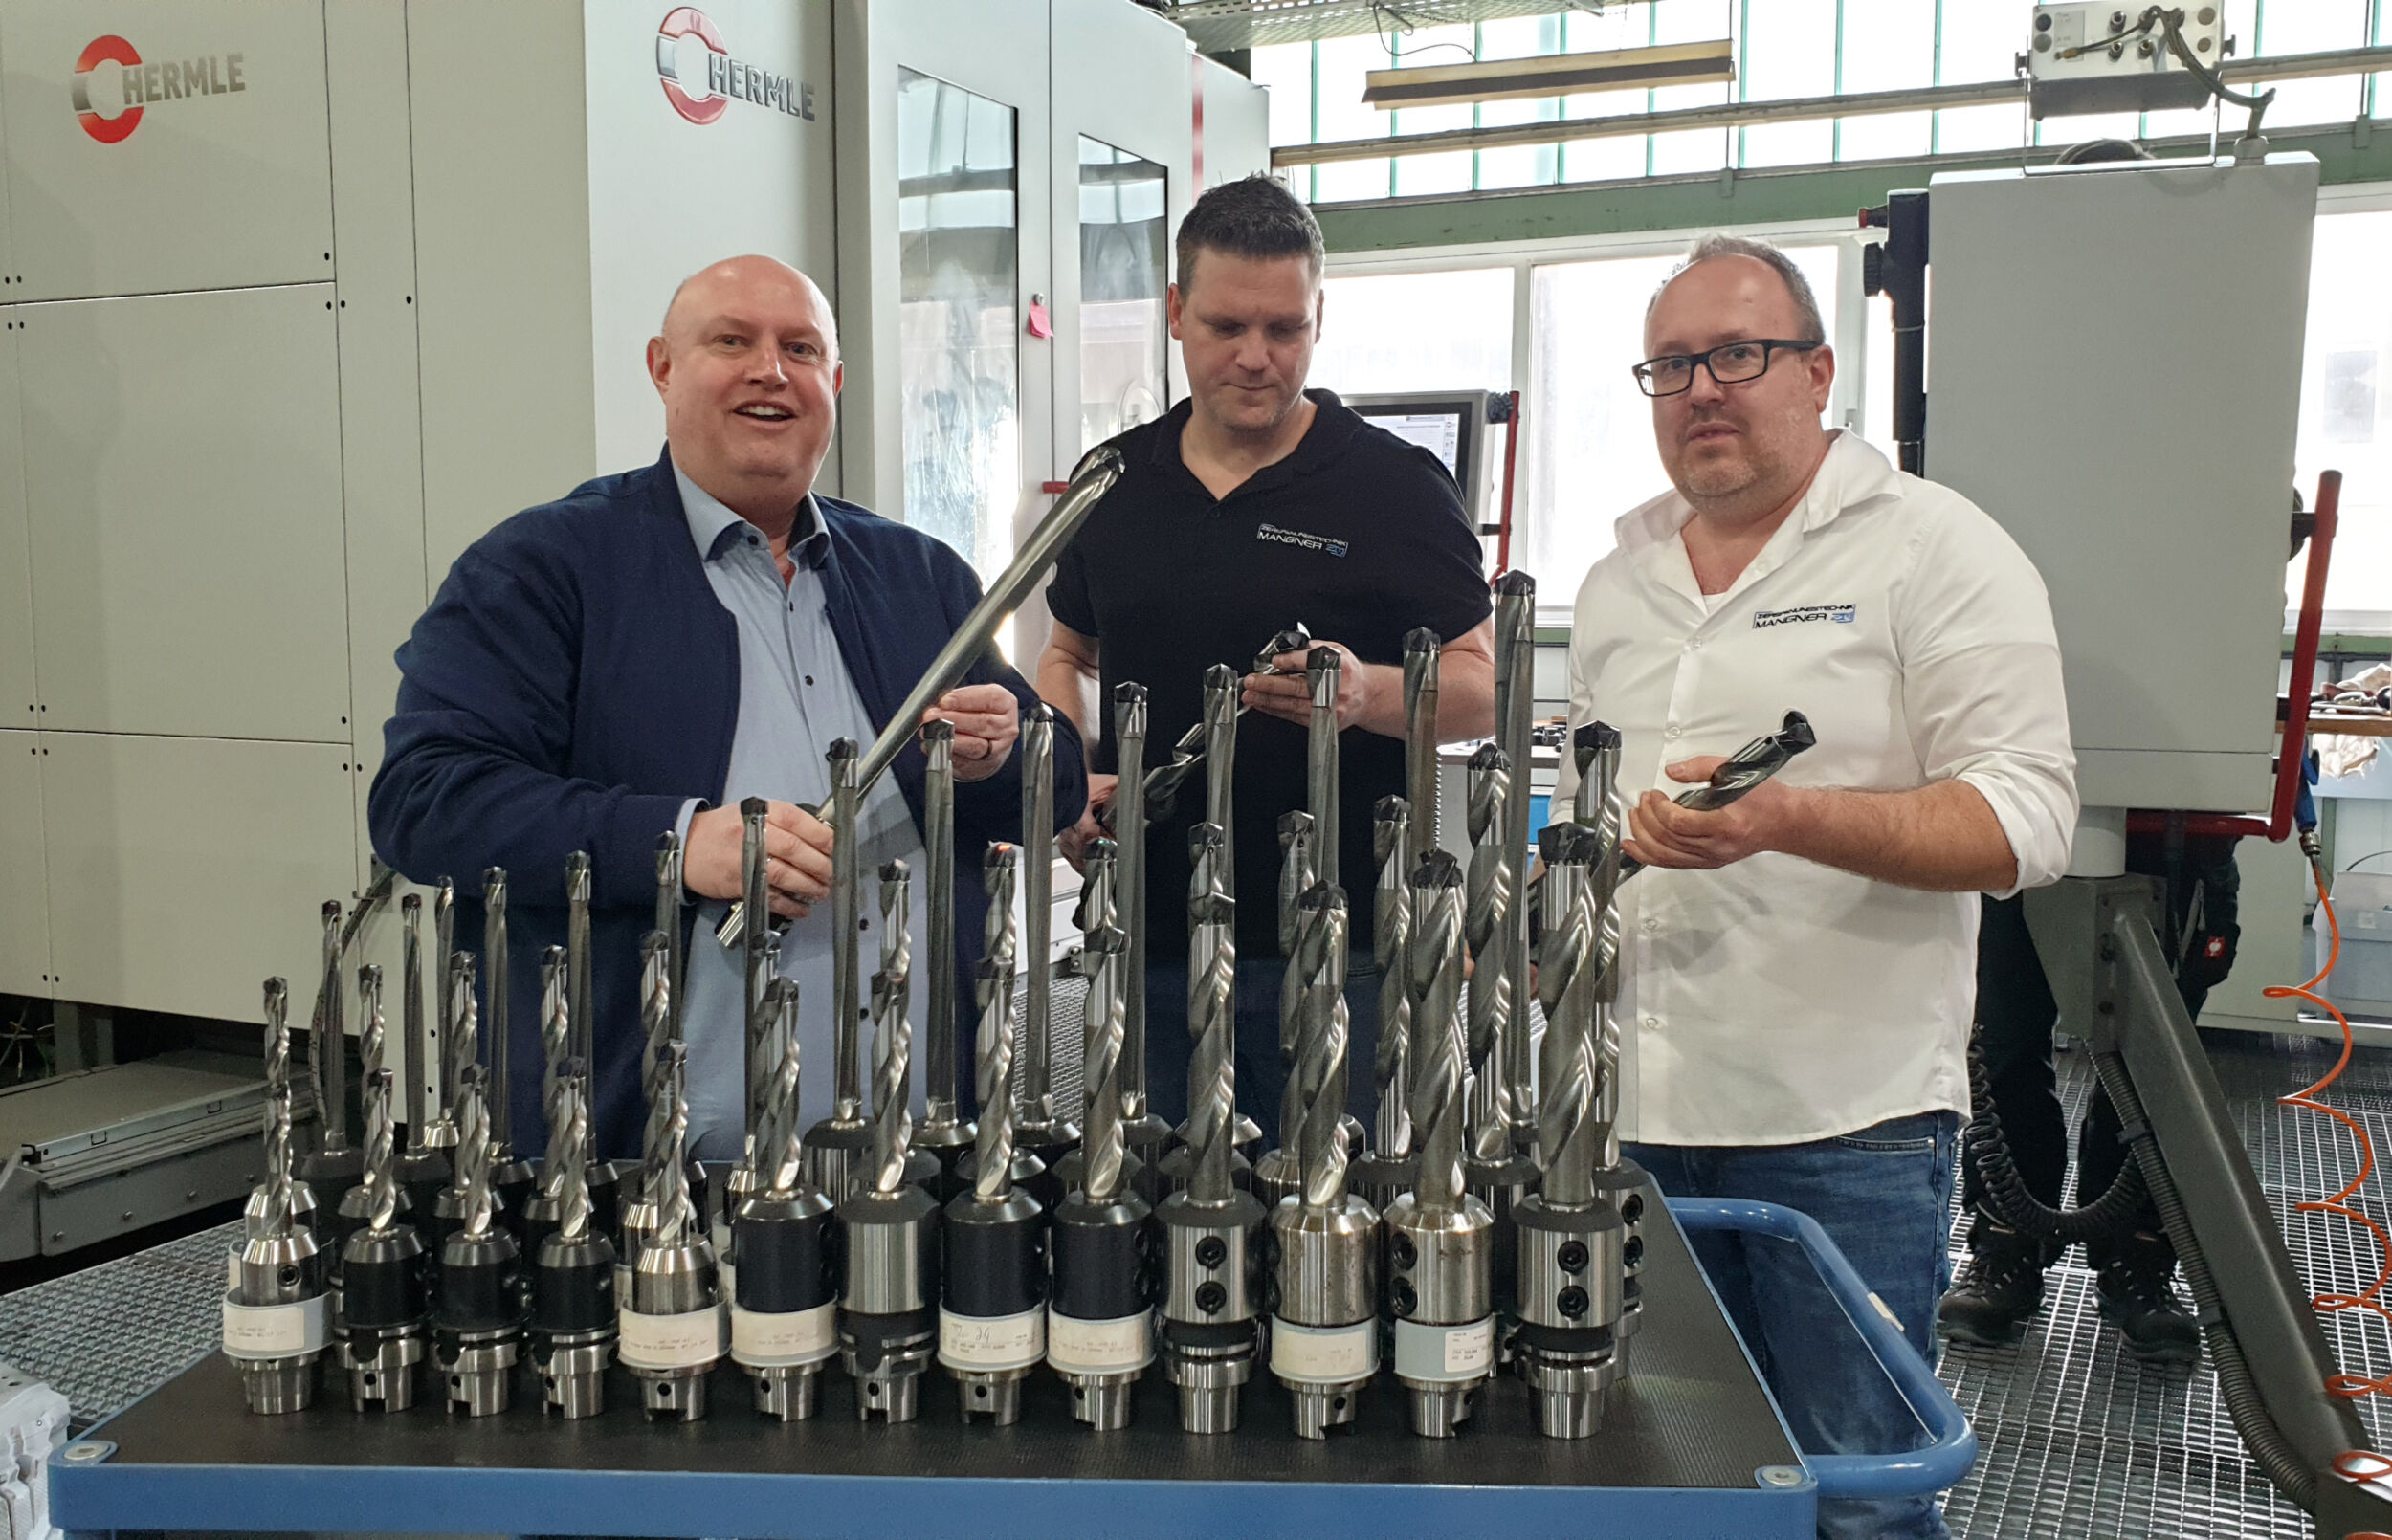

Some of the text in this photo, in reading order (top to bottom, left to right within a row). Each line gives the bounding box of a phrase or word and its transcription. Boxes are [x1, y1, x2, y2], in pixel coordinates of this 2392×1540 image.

[122, 52, 246, 105] HERMLE
[708, 53, 815, 121] HERMLE
[1258, 531, 1323, 550] MANGNER
[1755, 613, 1827, 628] MANGNER
